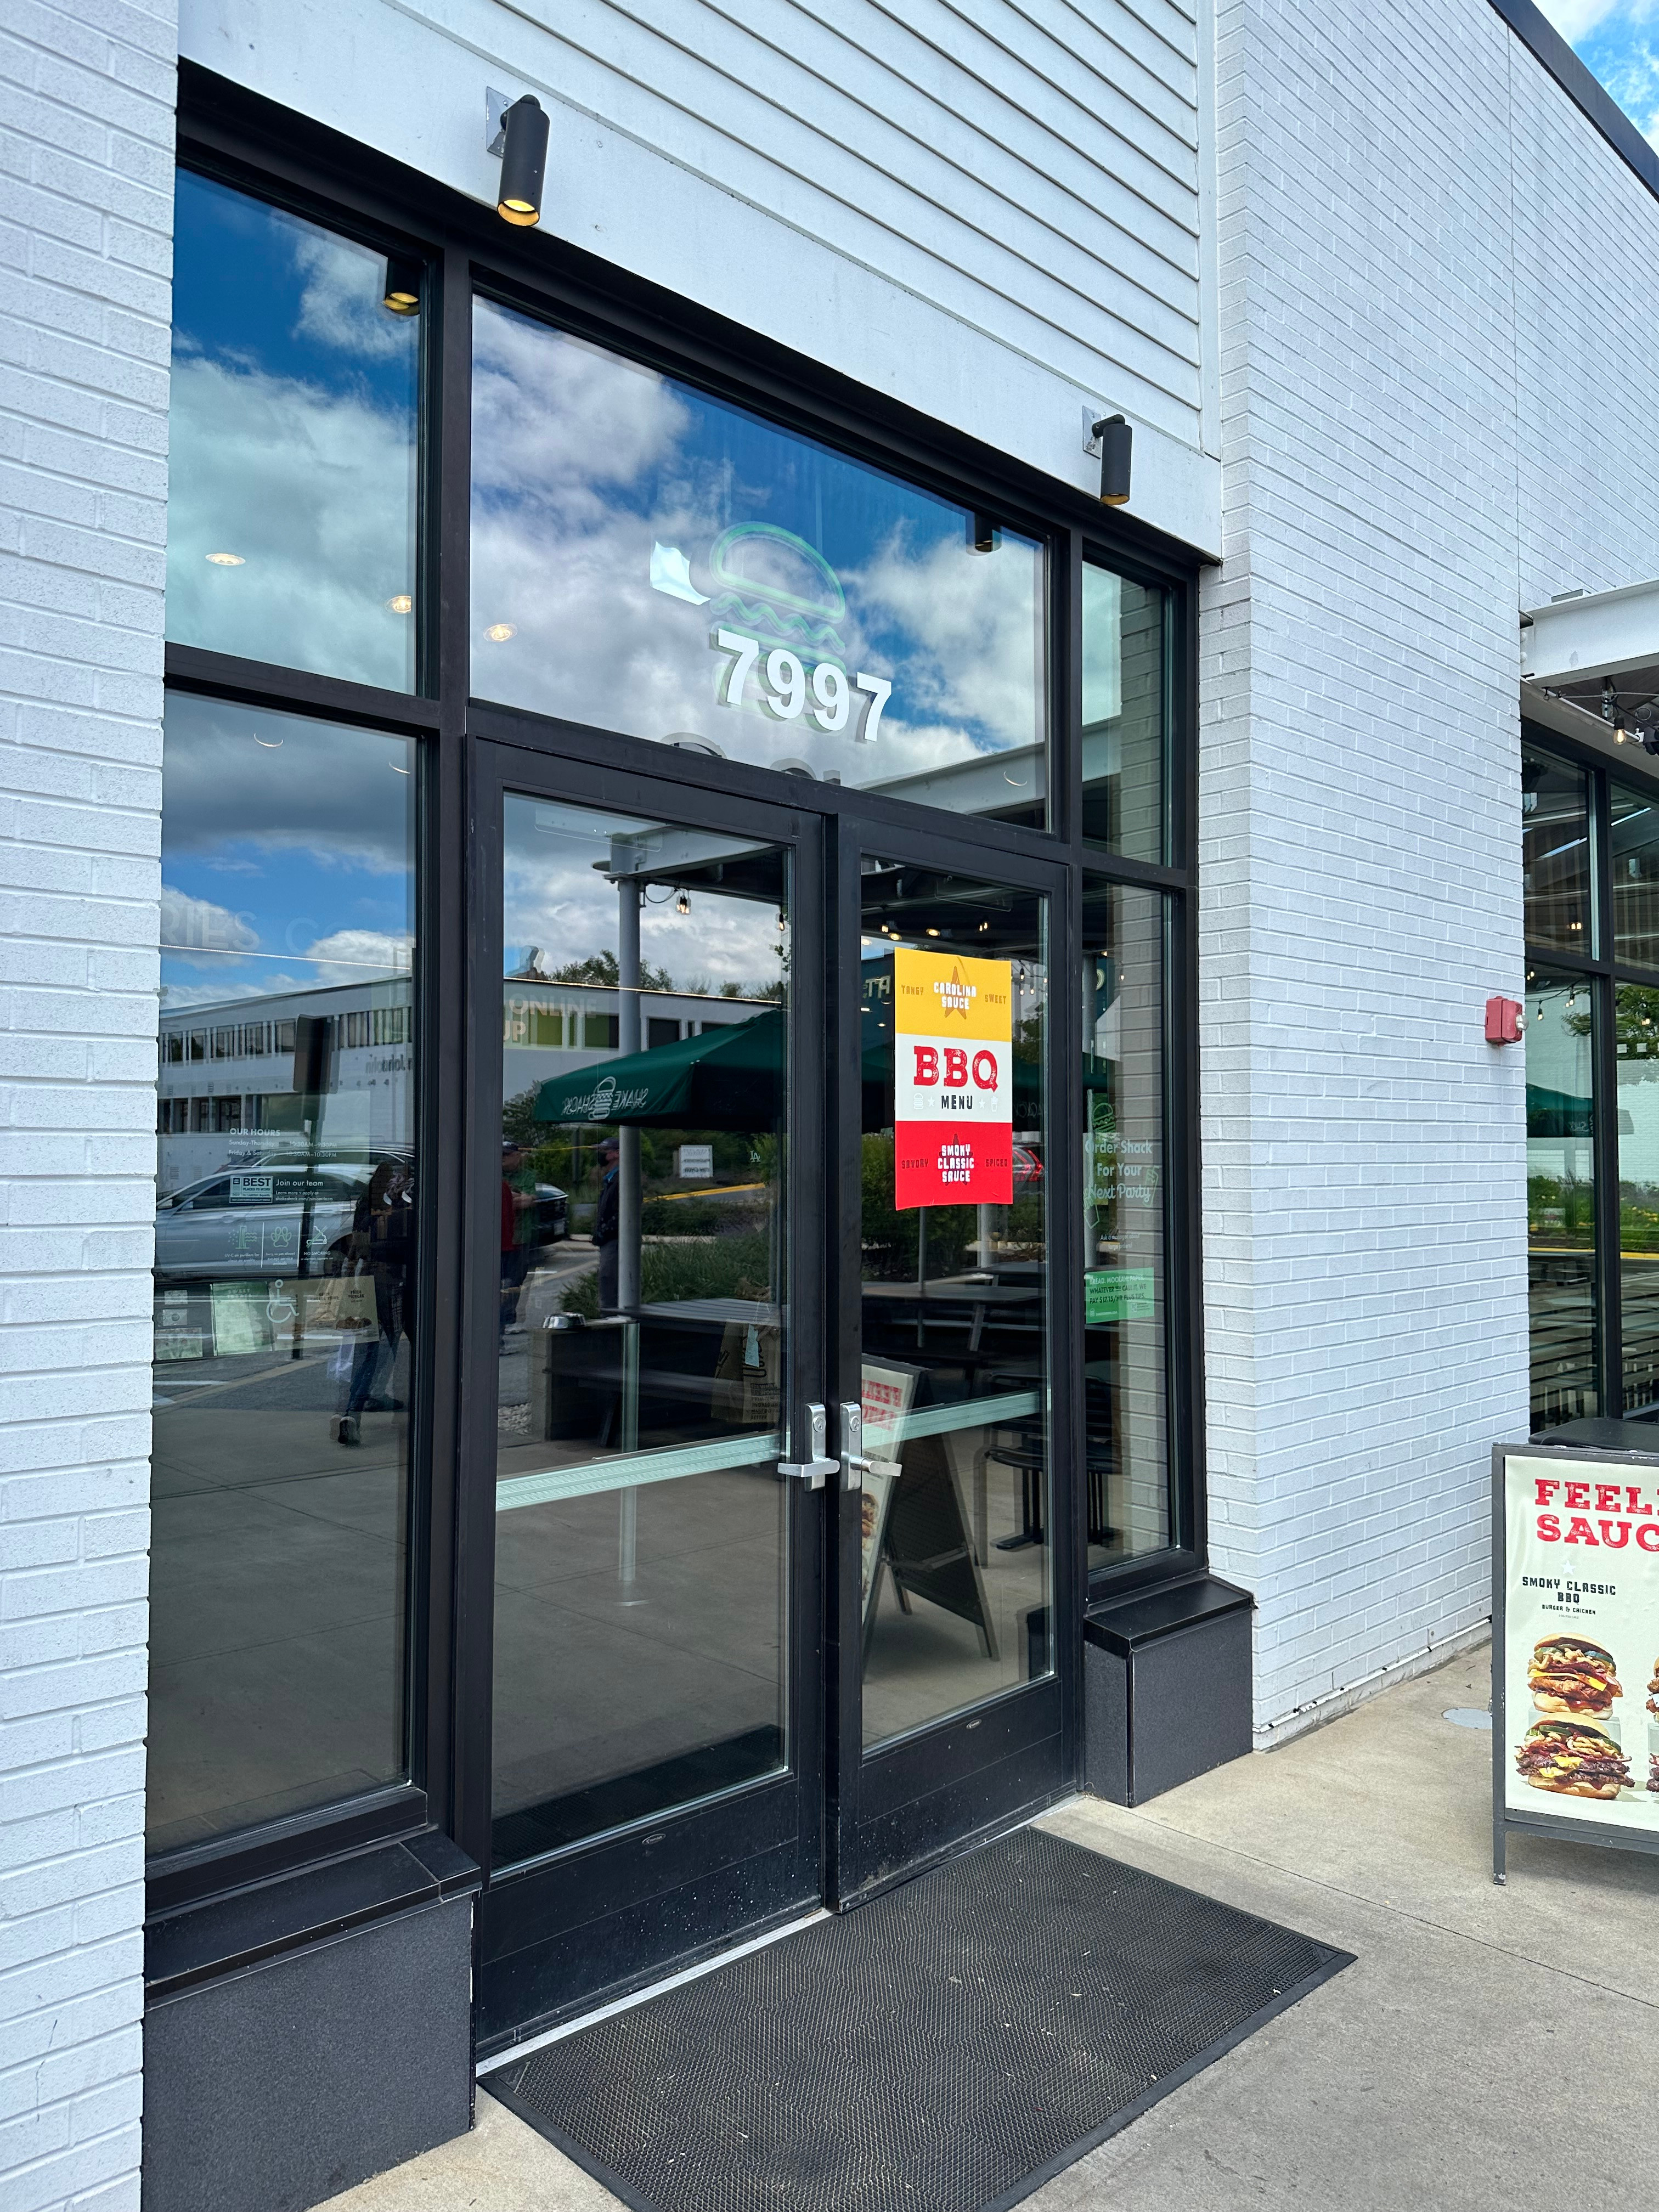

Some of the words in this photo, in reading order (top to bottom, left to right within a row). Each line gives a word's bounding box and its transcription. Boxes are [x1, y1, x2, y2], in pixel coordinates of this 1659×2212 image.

[718, 628, 891, 742] 7997
[901, 984, 924, 996] TANGY
[934, 981, 977, 997] CAROLINA
[509, 993, 597, 1019] ONLINE
[941, 996, 969, 1011] SAUCE
[985, 994, 1007, 1005] SWEET
[913, 1045, 997, 1093] BBQ
[941, 1094, 973, 1110] MENU
[250, 1128, 281, 1136] HOURS
[941, 1144, 970, 1157] SMOKY
[1085, 1139, 1118, 1154] Order
[1120, 1139, 1153, 1154] Shack
[901, 1158, 928, 1169] SAVORY
[937, 1156, 975, 1170] CLASSIC
[985, 1158, 1008, 1167] SPICED
[941, 1170, 971, 1183] SAUCE
[1097, 1163, 1115, 1177] For
[1117, 1163, 1142, 1177] Your
[243, 1177, 271, 1187] BEST
[275, 1178, 291, 1187] Join
[1088, 1183, 1116, 1200] Next
[1117, 1183, 1151, 1203] Party
[1089, 1285, 1114, 1295] WHATEVER
[1089, 1296, 1099, 1305] PAY
[1535, 1478, 1659, 1515] FEEL
[1522, 1576, 1560, 1589] SMOKY
[1566, 1581, 1616, 1595] CLASSIC
[1558, 1592, 1580, 1605] BBQ
[1542, 1604, 1564, 1612] BURGER
